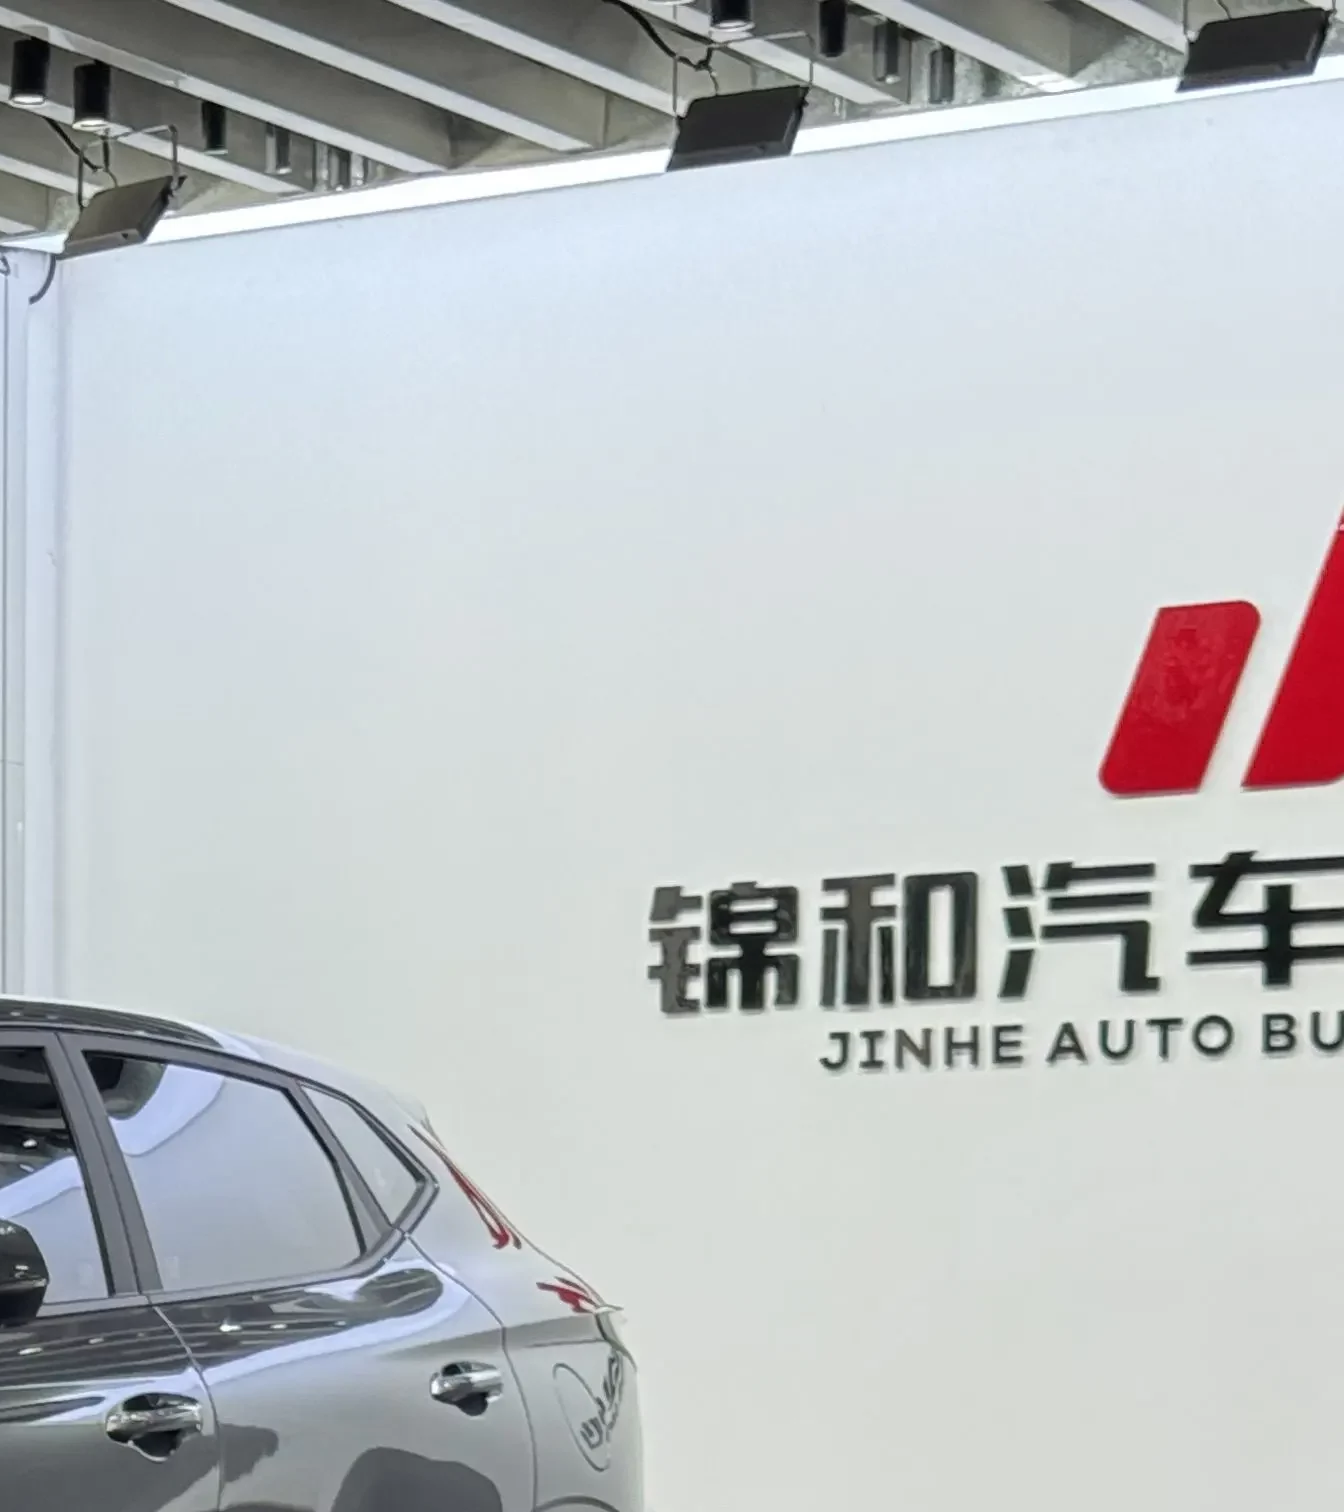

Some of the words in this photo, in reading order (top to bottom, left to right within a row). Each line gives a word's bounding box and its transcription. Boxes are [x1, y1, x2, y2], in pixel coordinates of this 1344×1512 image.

[647, 850, 1344, 1014] 锦和汽车
[819, 1024, 1025, 1071] JINHE
[1045, 1014, 1235, 1063] AUTO
[1261, 1009, 1344, 1055] BU
